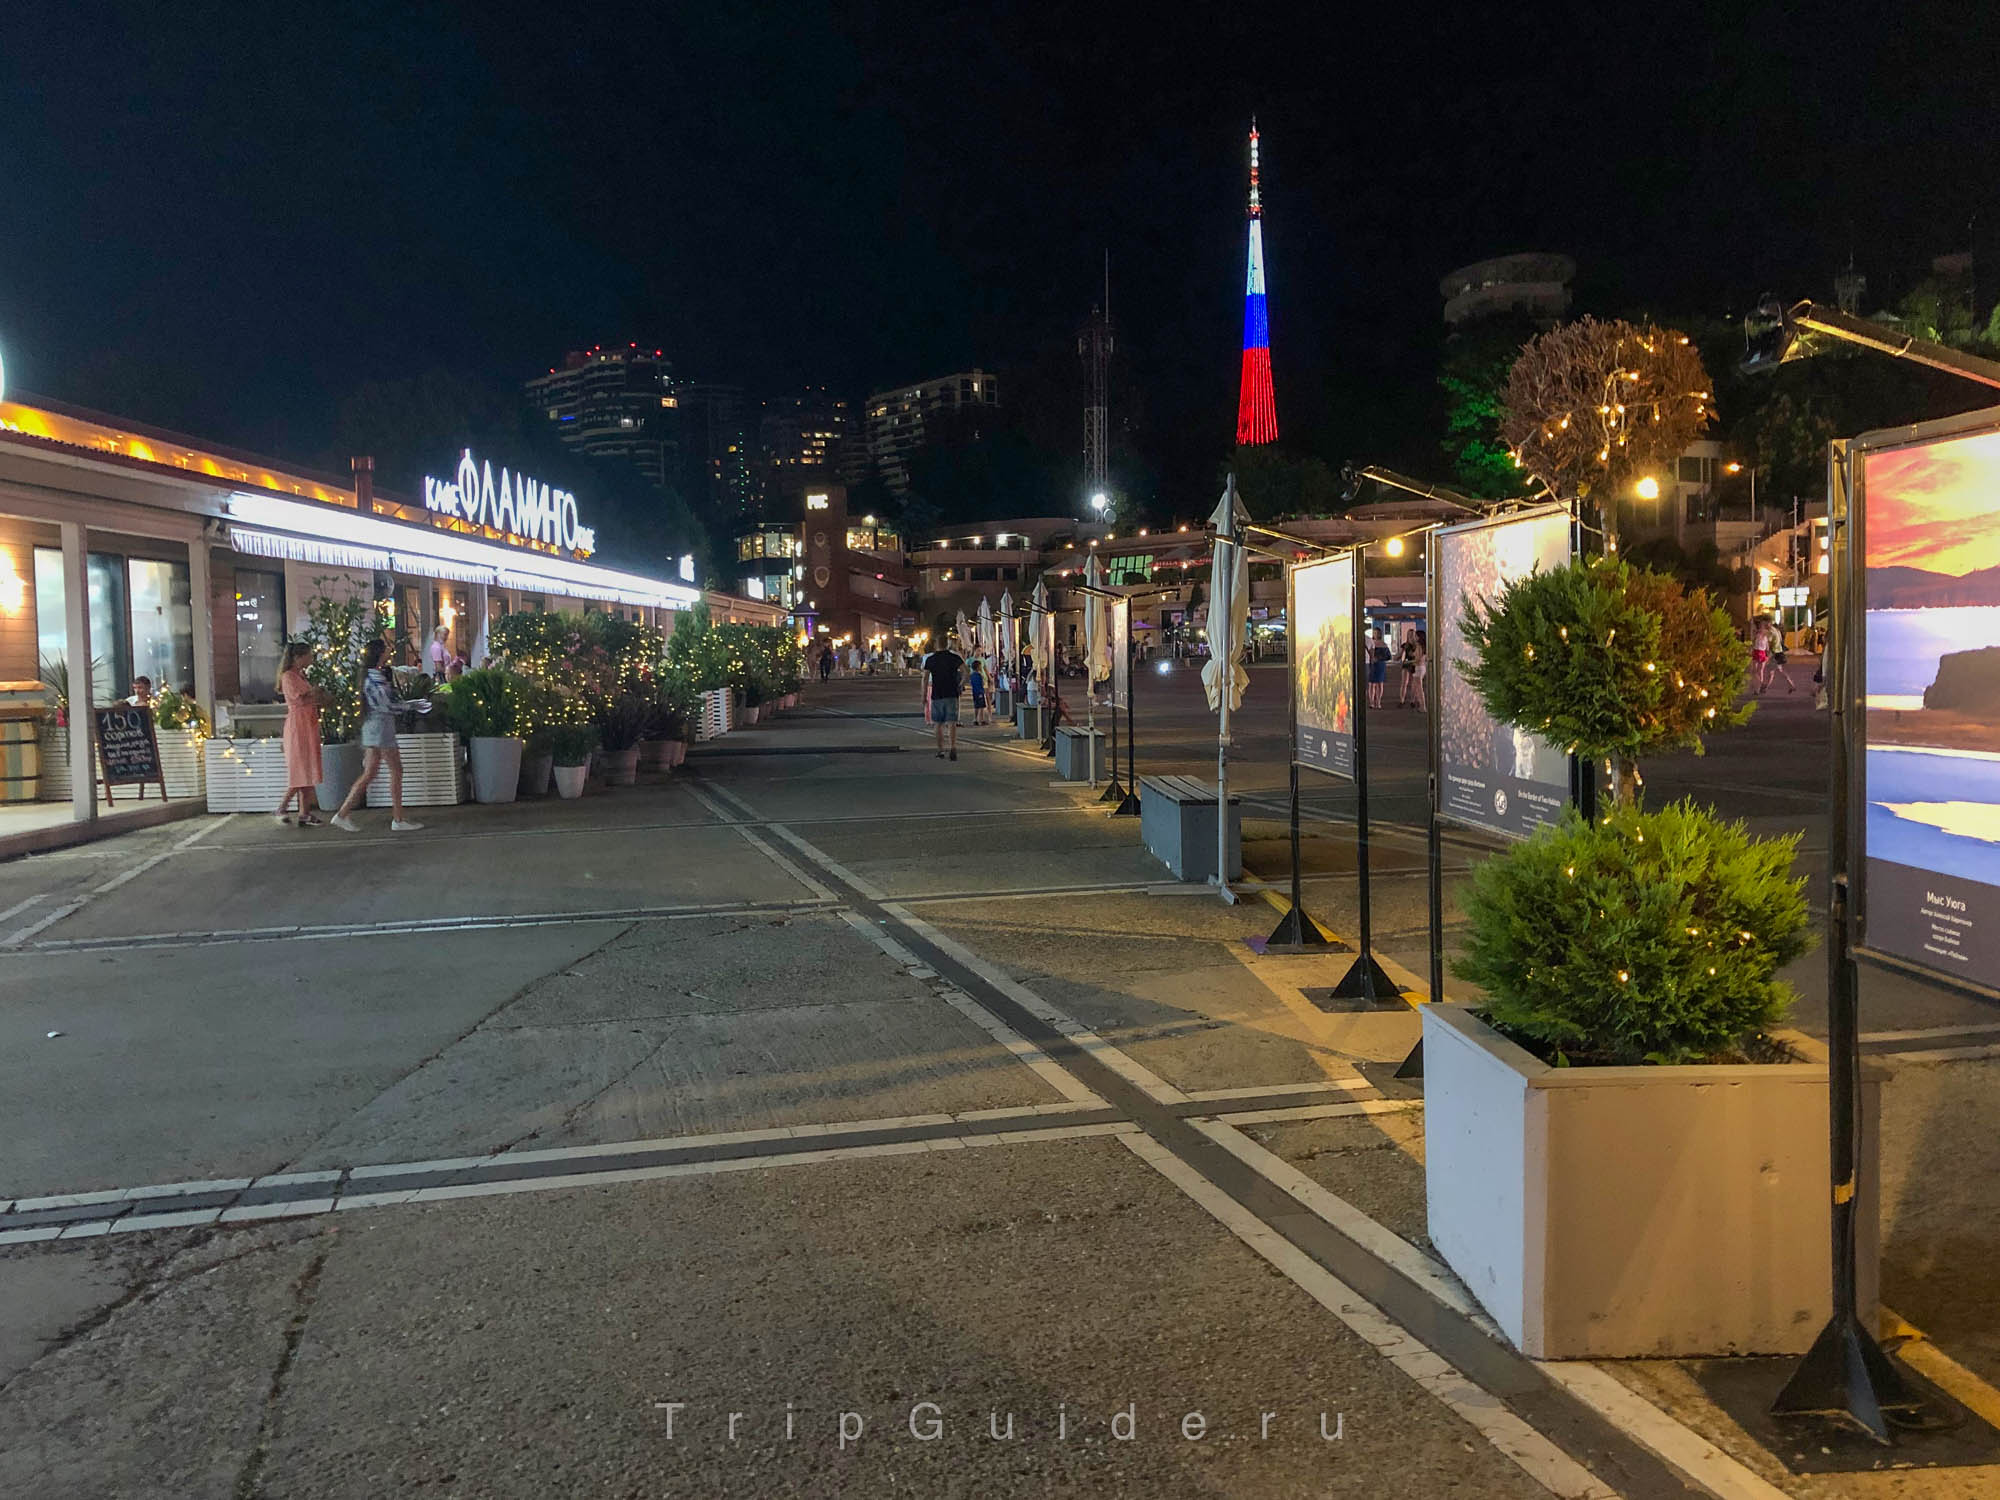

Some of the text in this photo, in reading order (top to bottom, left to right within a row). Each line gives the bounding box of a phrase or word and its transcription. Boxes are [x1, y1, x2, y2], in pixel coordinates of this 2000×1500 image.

[458, 447, 579, 551] ФЛАМИНГО
[102, 711, 142, 732] 150
[1927, 891, 1966, 912] Мыс Уюга
